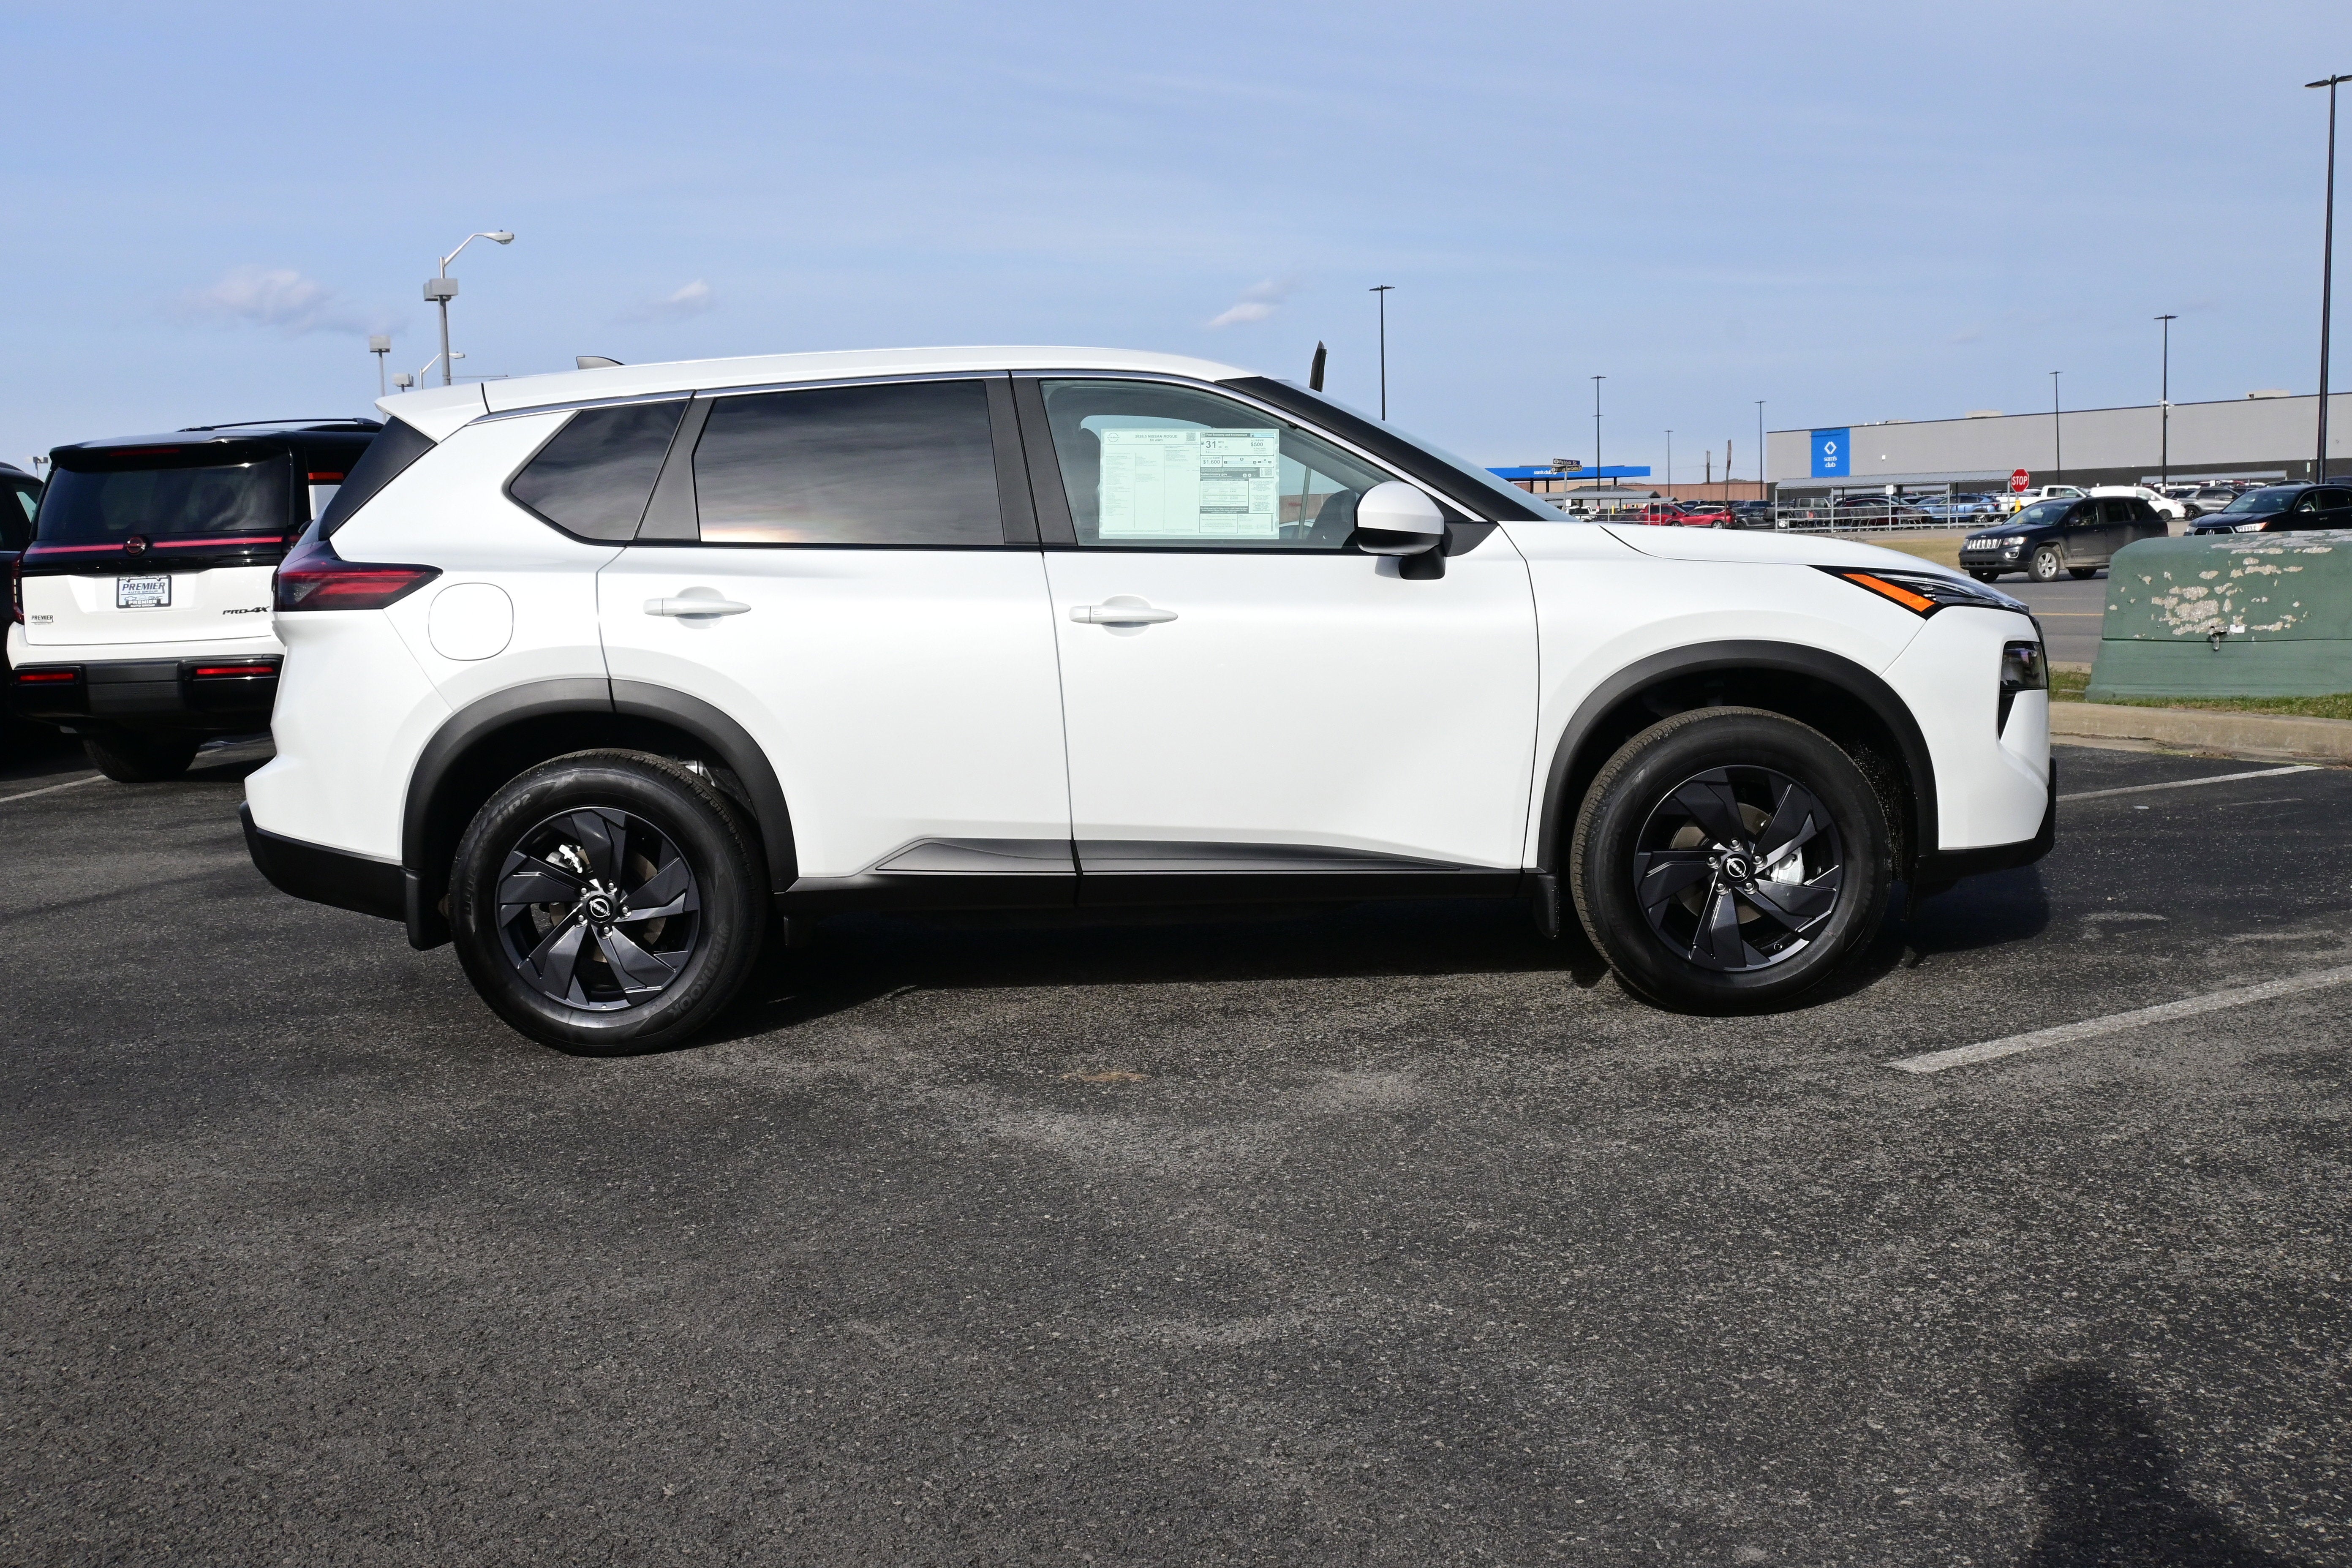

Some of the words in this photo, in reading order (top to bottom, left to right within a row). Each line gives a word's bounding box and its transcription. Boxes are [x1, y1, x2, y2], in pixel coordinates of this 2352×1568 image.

[2012, 476, 2028, 485] STOP
[122, 582, 166, 593] PREMIER
[223, 606, 270, 615] PRO-4X
[1727, 858, 1746, 877] NISSAN
[589, 900, 610, 916] NISSAN
